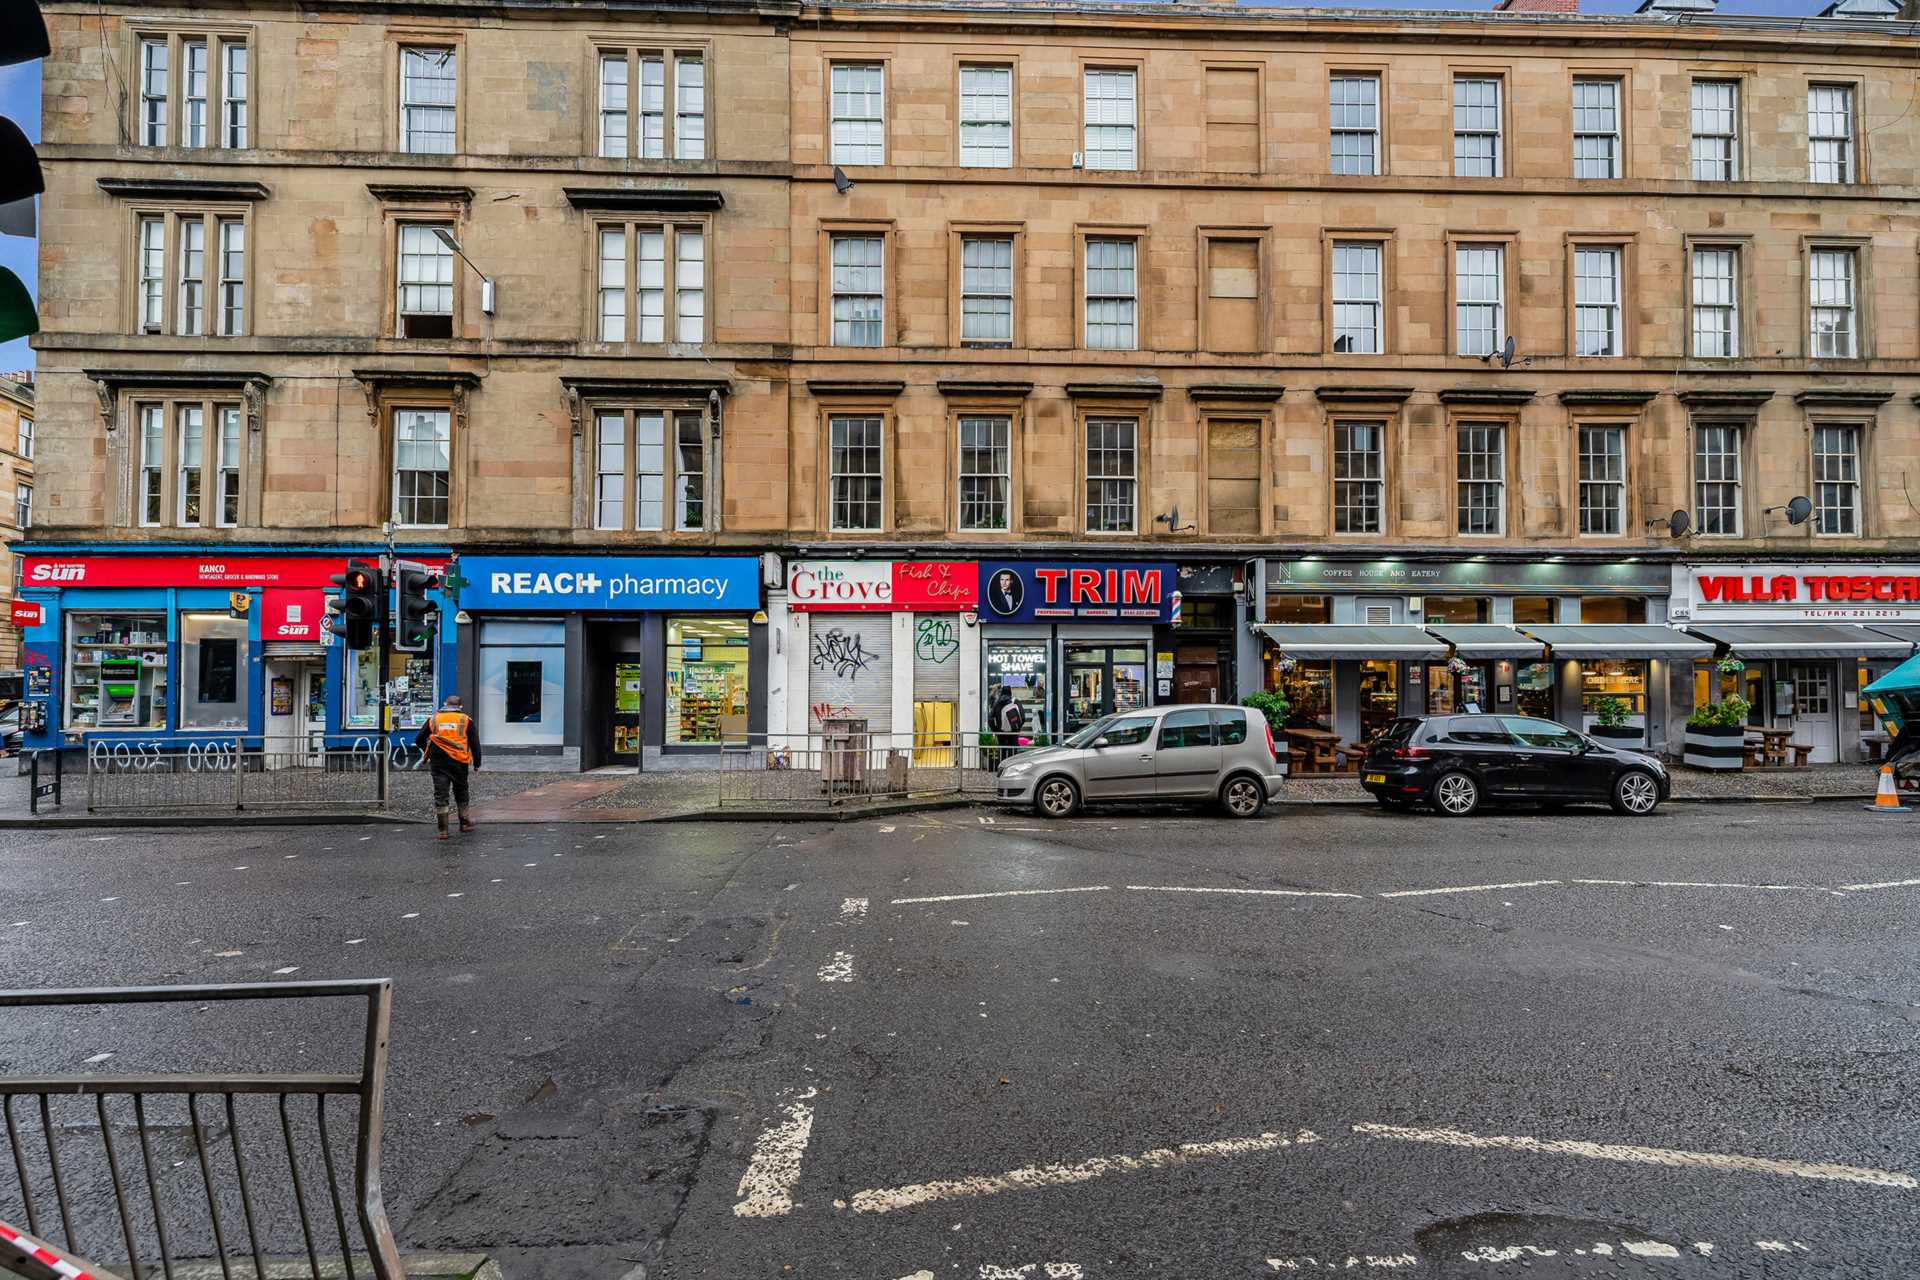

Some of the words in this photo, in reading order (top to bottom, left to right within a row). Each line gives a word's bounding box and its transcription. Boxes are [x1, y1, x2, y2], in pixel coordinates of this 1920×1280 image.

[31, 564, 86, 581] Sun
[199, 564, 225, 573] KANCO
[817, 566, 844, 581] the
[898, 563, 932, 579] Fish
[1322, 569, 1353, 577] COFFEE
[1359, 569, 1384, 577] HOUSE
[1390, 569, 1406, 577] AND
[1411, 569, 1441, 577] EATERY
[609, 573, 729, 600] pharmacy
[790, 570, 892, 600] Grove
[927, 580, 971, 601] Chips
[1035, 568, 1162, 604] TRIM
[1697, 575, 1797, 602] VILLA
[1803, 575, 1920, 602] TOSCA
[14, 609, 38, 619] Sun
[277, 625, 309, 635] Sun
[988, 654, 1010, 663] HOT
[1012, 654, 1046, 664] TOWEL
[1001, 662, 1034, 672] SHAVE
